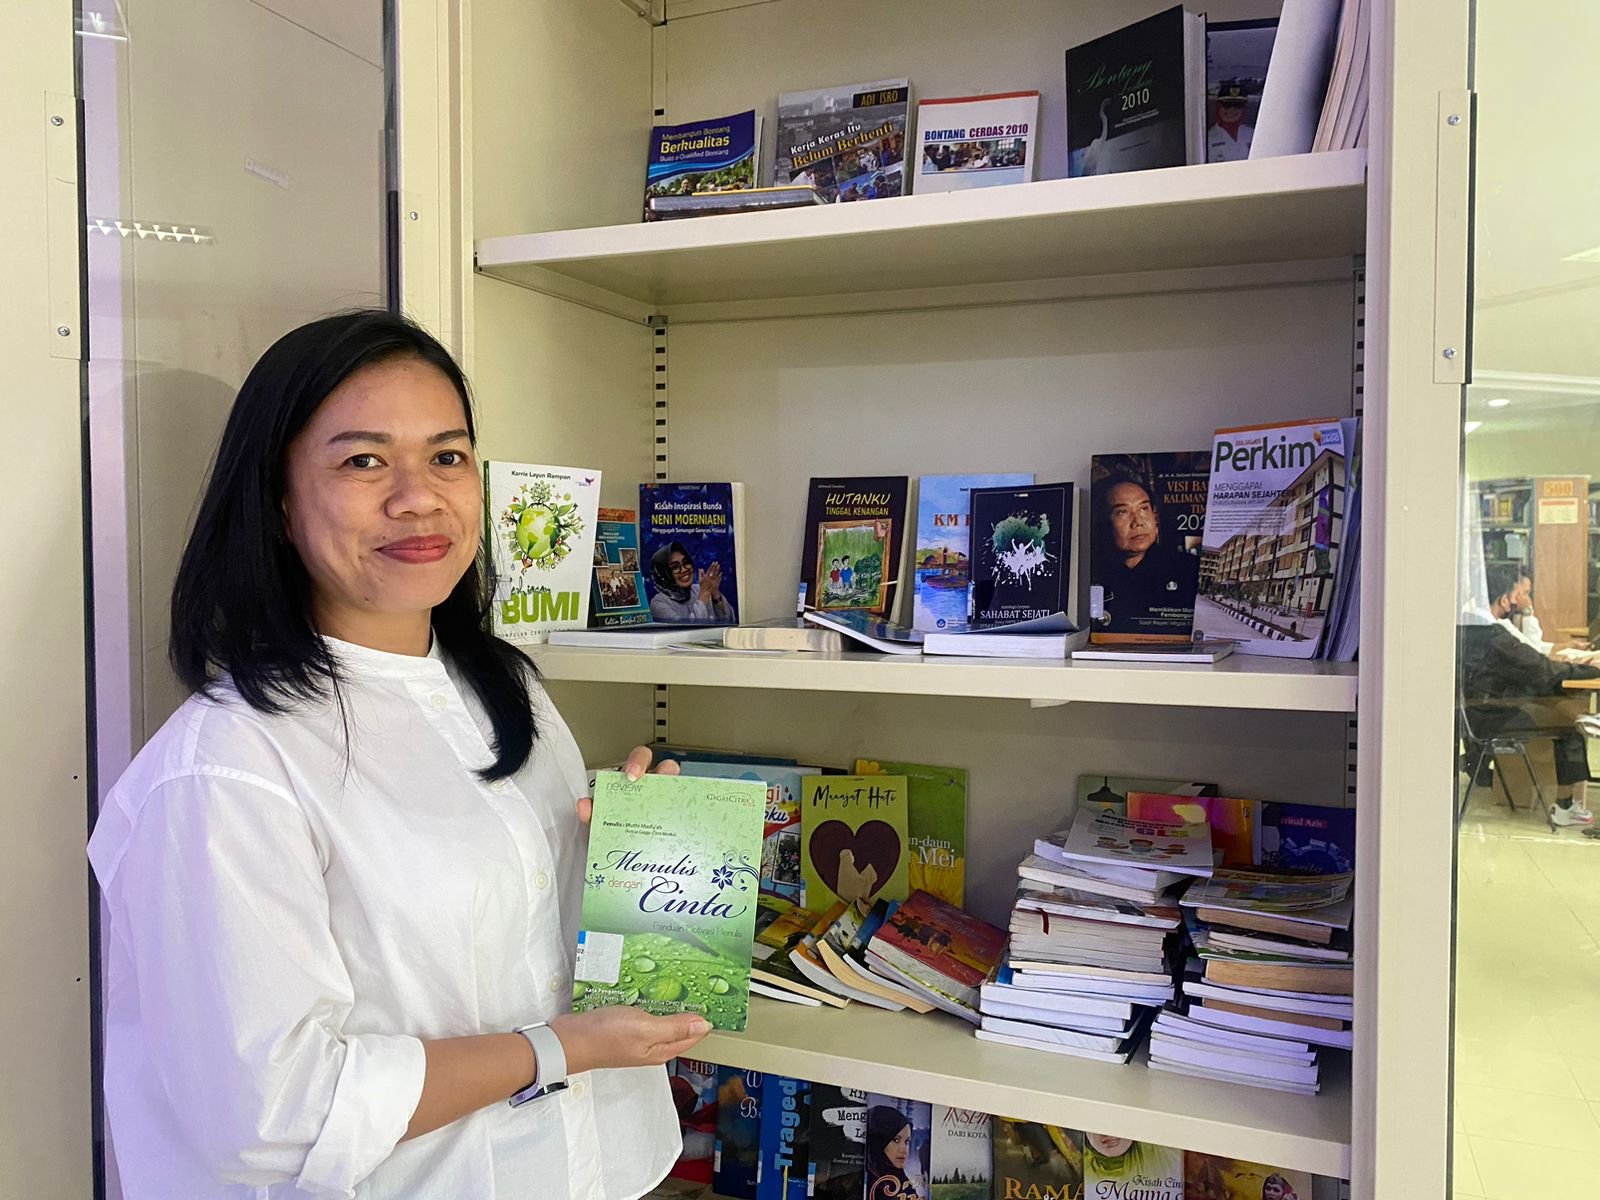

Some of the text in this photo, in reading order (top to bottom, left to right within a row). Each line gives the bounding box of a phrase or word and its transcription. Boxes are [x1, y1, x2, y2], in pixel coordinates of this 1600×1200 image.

[861, 90, 898, 106] ADI ISRO
[1121, 88, 1150, 111] 2010
[790, 122, 861, 155] Kerja Keras Itu
[924, 123, 1029, 141] BONTANG CERDAS 2010
[660, 136, 730, 154] Berkualitas
[792, 121, 894, 168] Belum Berhenti
[1214, 435, 1316, 473] Perkim
[546, 472, 571, 480] Rampan
[1167, 480, 1208, 492] VISI BA
[1214, 481, 1263, 491] MENGGAPAI
[825, 492, 891, 505] HUTANKU
[1163, 493, 1206, 504] KALIMAN
[1213, 491, 1251, 500] HARAPAN
[654, 501, 722, 512] Kisah Inspirasi Bunda
[825, 506, 889, 516] TINGGAL KENANGAN
[651, 514, 726, 525] NENI MOERNIAENI
[933, 513, 959, 527] KM
[501, 591, 580, 625] BUMI
[980, 609, 1050, 621] SAHABAT SEJATI
[867, 786, 897, 809] Hati
[909, 835, 951, 849] n-daun
[592, 849, 699, 877] Menulis
[918, 846, 955, 868] Mei
[607, 876, 643, 893] dengan
[638, 875, 748, 919] Cinta
[653, 921, 685, 932] Panduan
[598, 988, 625, 996] Pengantar
[837, 1110, 867, 1123] Meng
[774, 1079, 800, 1171] Traged
[947, 1129, 988, 1140] DARI KOTA
[1132, 1174, 1183, 1189] Kisah Cin
